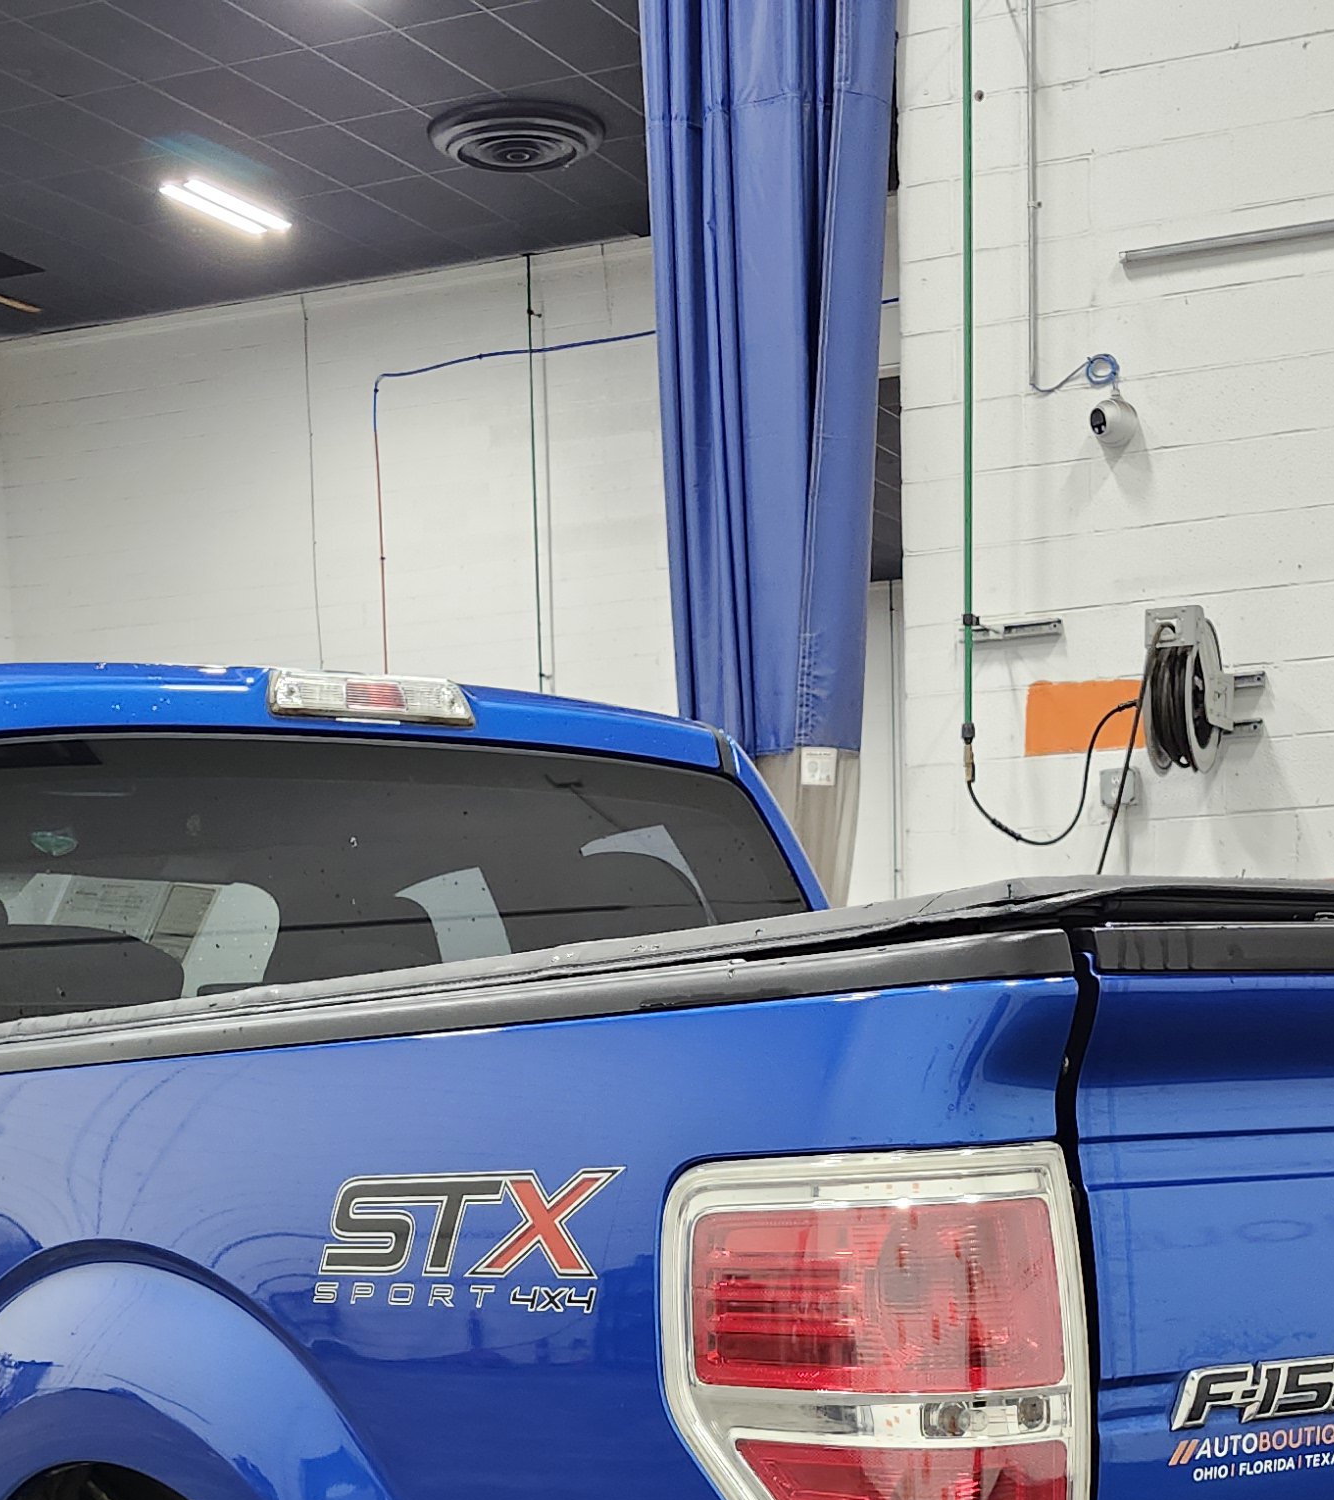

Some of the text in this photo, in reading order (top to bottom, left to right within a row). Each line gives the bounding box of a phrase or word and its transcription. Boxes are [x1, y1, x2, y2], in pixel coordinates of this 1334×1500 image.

[318, 1166, 627, 1279] STX
[313, 1282, 496, 1309] SPORT
[1192, 1464, 1229, 1483] OHIO
[1238, 1458, 1296, 1477] FLORIDA
